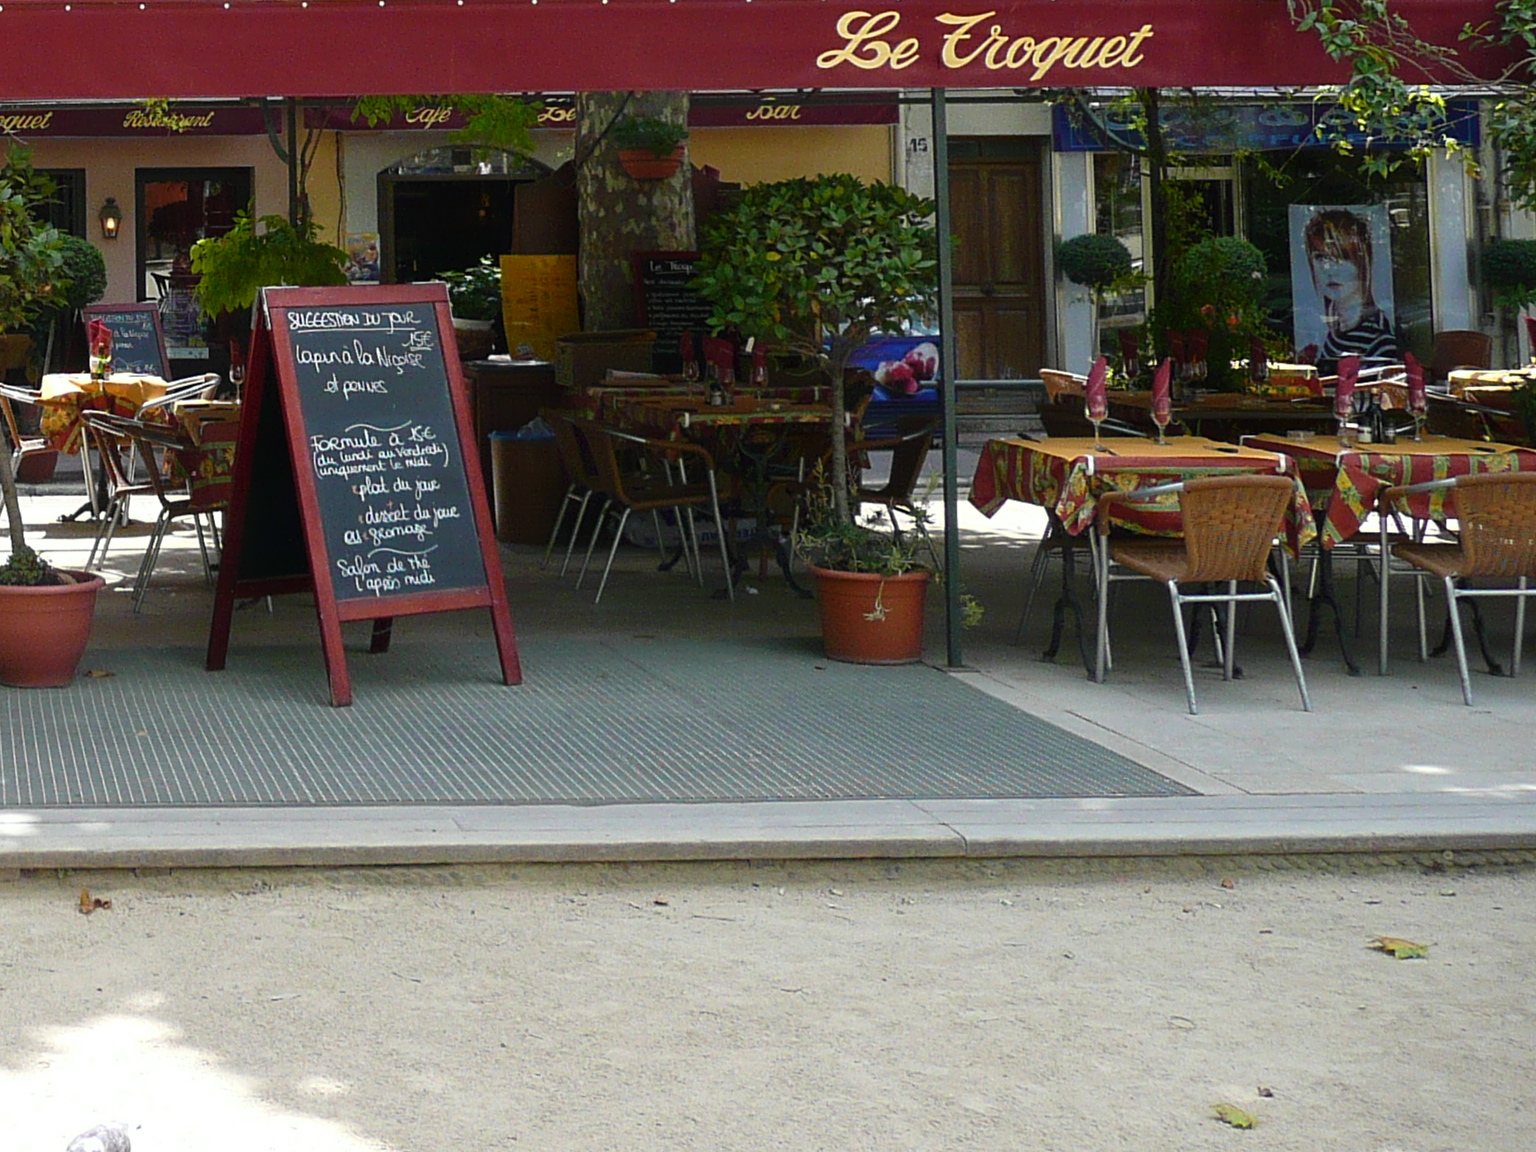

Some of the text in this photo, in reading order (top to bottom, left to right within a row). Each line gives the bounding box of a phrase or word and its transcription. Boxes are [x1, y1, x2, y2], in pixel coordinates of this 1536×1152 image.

[816, 10, 1154, 81] Le Troquet
[406, 106, 453, 129] Café
[909, 138, 928, 152] 15
[287, 311, 421, 334] SUGGESTION DU JOUR
[402, 331, 434, 348] 15€
[353, 339, 375, 366] la
[378, 448, 396, 460] au
[393, 476, 412, 491] du
[413, 504, 432, 520] du
[337, 554, 381, 581] Salon
[386, 557, 406, 574] de
[404, 569, 436, 586] midi
